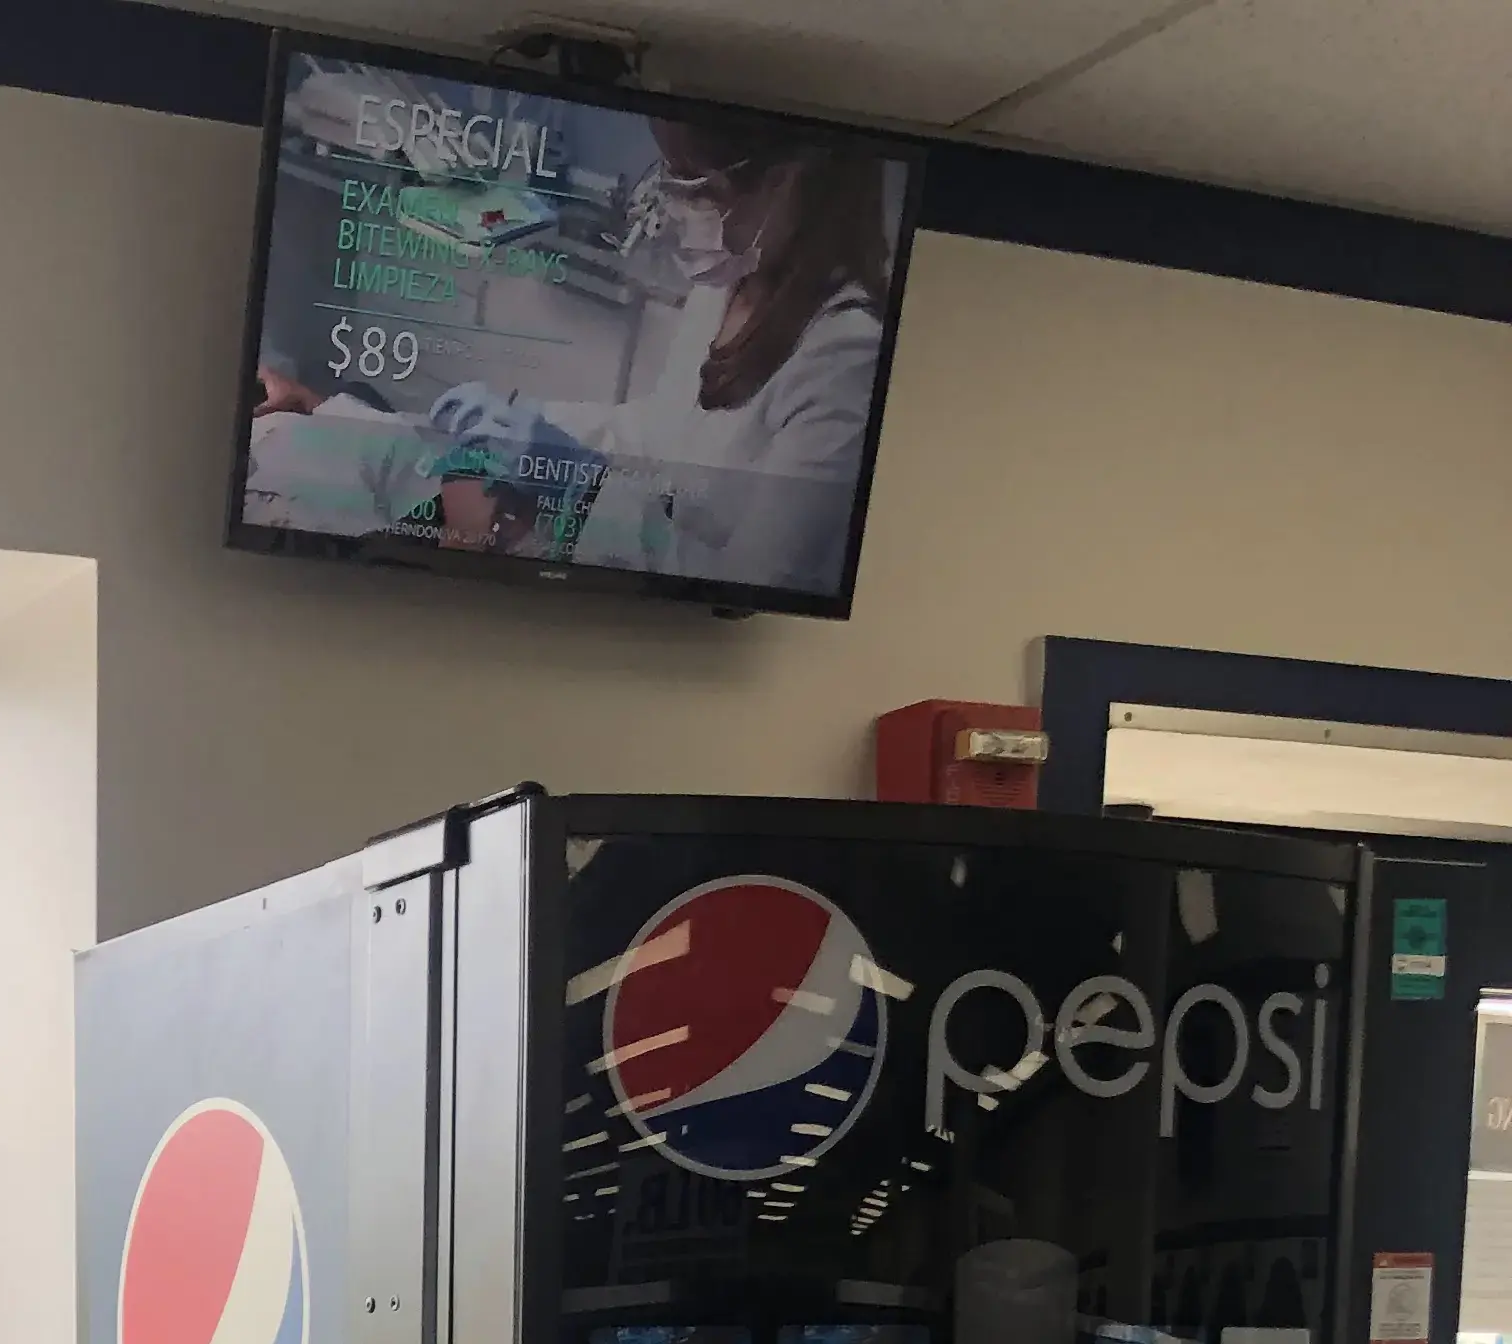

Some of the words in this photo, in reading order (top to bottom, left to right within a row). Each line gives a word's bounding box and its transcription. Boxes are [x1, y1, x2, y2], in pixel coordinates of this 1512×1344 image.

[355, 95, 557, 179] ESPECIAL
[337, 218, 469, 269] BITEWING
[332, 258, 458, 302] LIMPIEZA
[327, 315, 420, 381] $89
[518, 454, 610, 487] DENTISTA
[925, 962, 1331, 1143] pepsi
